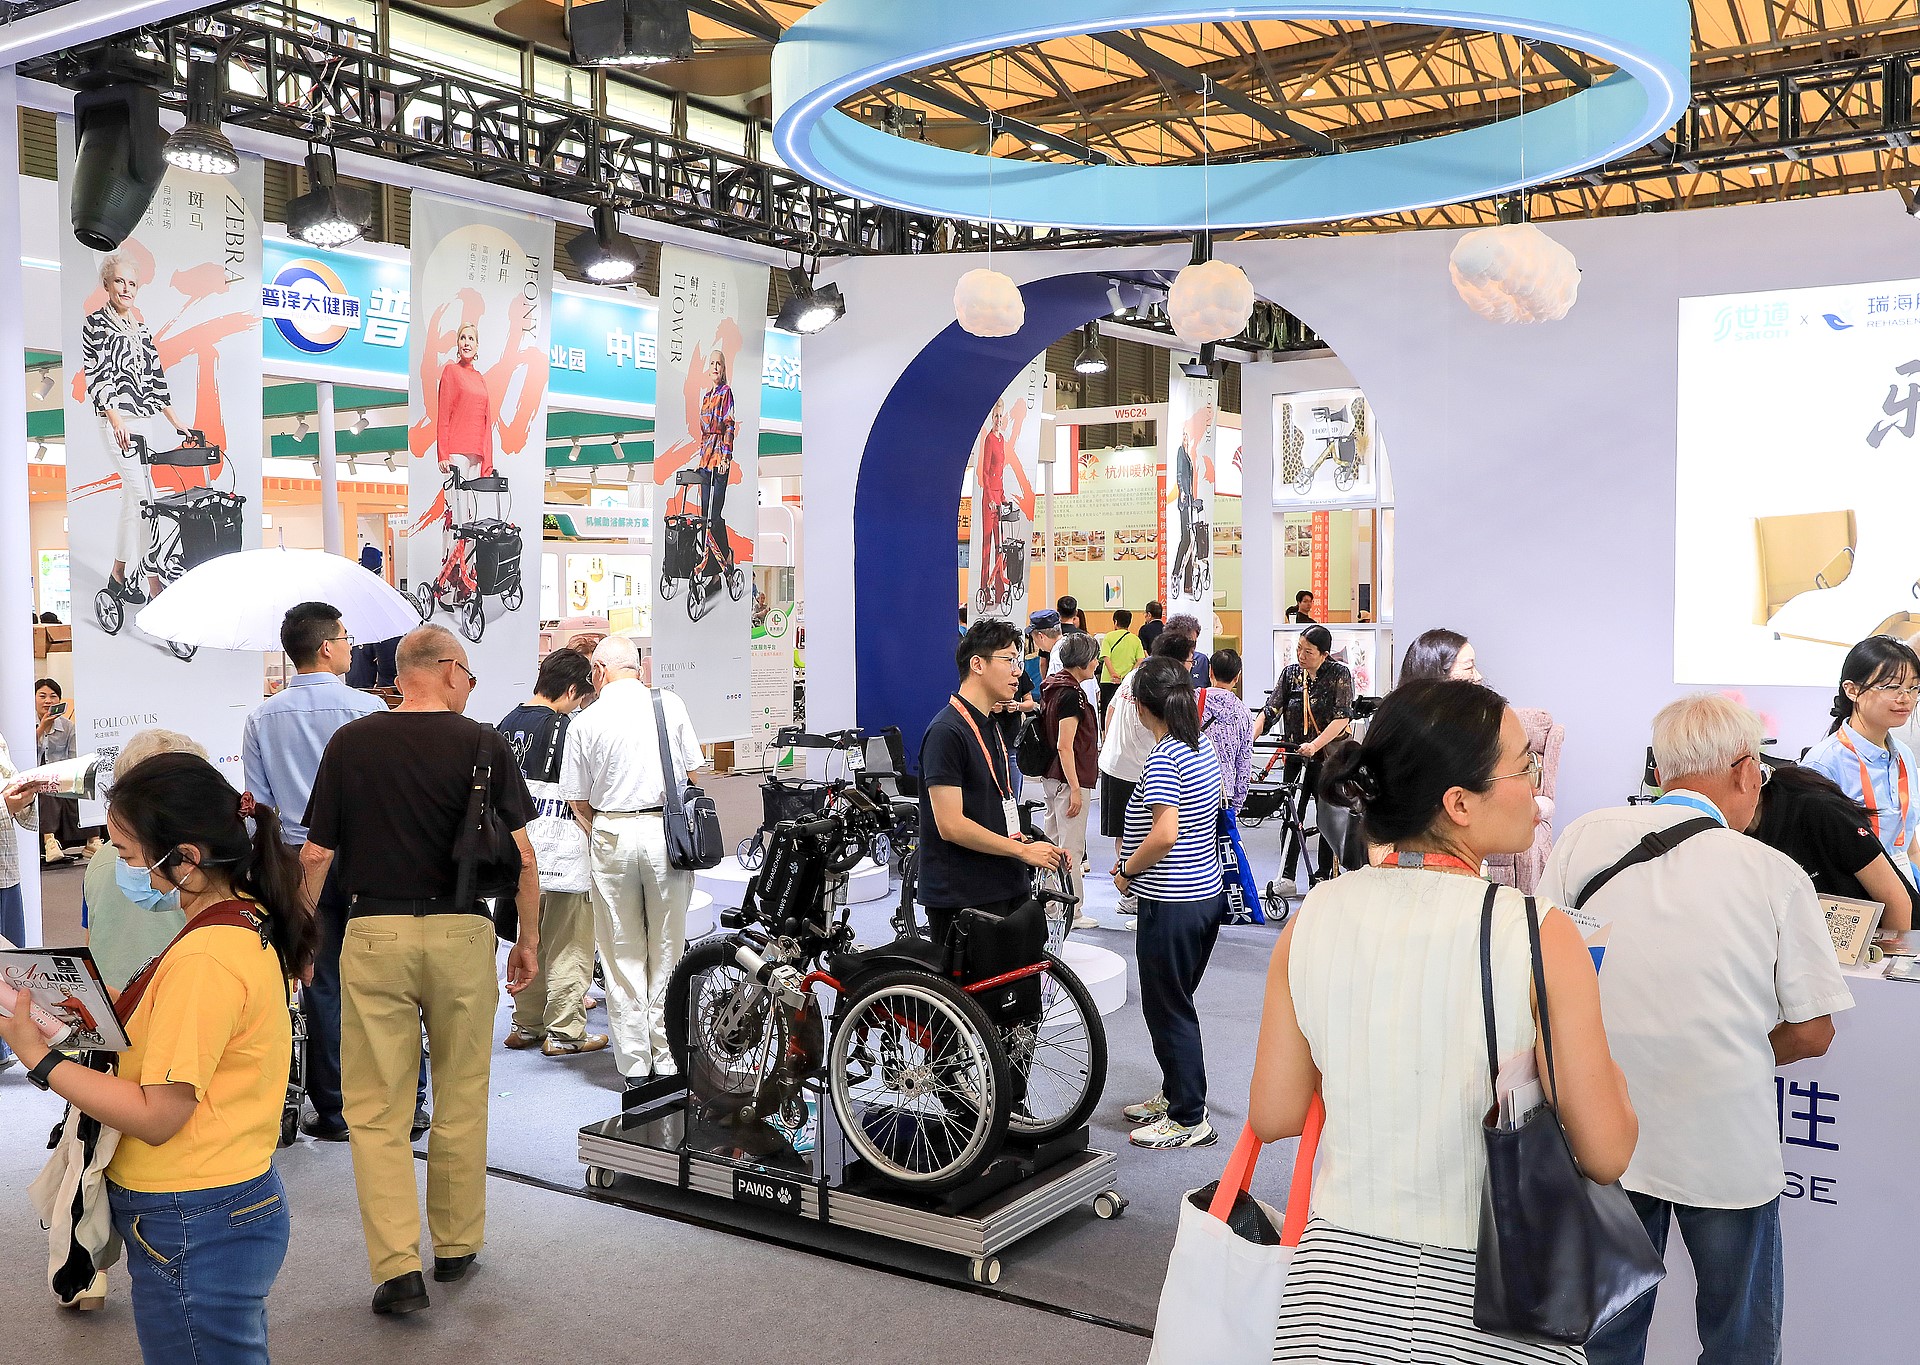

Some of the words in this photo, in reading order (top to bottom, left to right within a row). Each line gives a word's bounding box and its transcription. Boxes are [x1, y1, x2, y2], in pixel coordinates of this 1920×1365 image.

[163, 185, 172, 230] 自成主场
[187, 190, 205, 232] 斑马
[224, 194, 245, 286] ZEBRA
[498, 248, 511, 284] 牡丹
[262, 287, 360, 318] 普泽大健康
[521, 254, 540, 340] PEONY
[689, 275, 699, 308] 鲜花
[362, 287, 411, 349] 普
[550, 343, 587, 373] 业园
[606, 327, 658, 372] 中国
[670, 272, 687, 364] FLOWER
[1027, 358, 1038, 410] LOUD
[1114, 407, 1148, 419] W5C24
[1104, 463, 1158, 480] 杭州暖树
[586, 515, 650, 528] 机械助浴解决方案
[93, 714, 141, 730] FOLLOW
[143, 712, 158, 725] US
[776, 898, 788, 918] PAWS
[13, 979, 88, 993] ROLLATORS
[737, 1178, 774, 1200] PAWS
